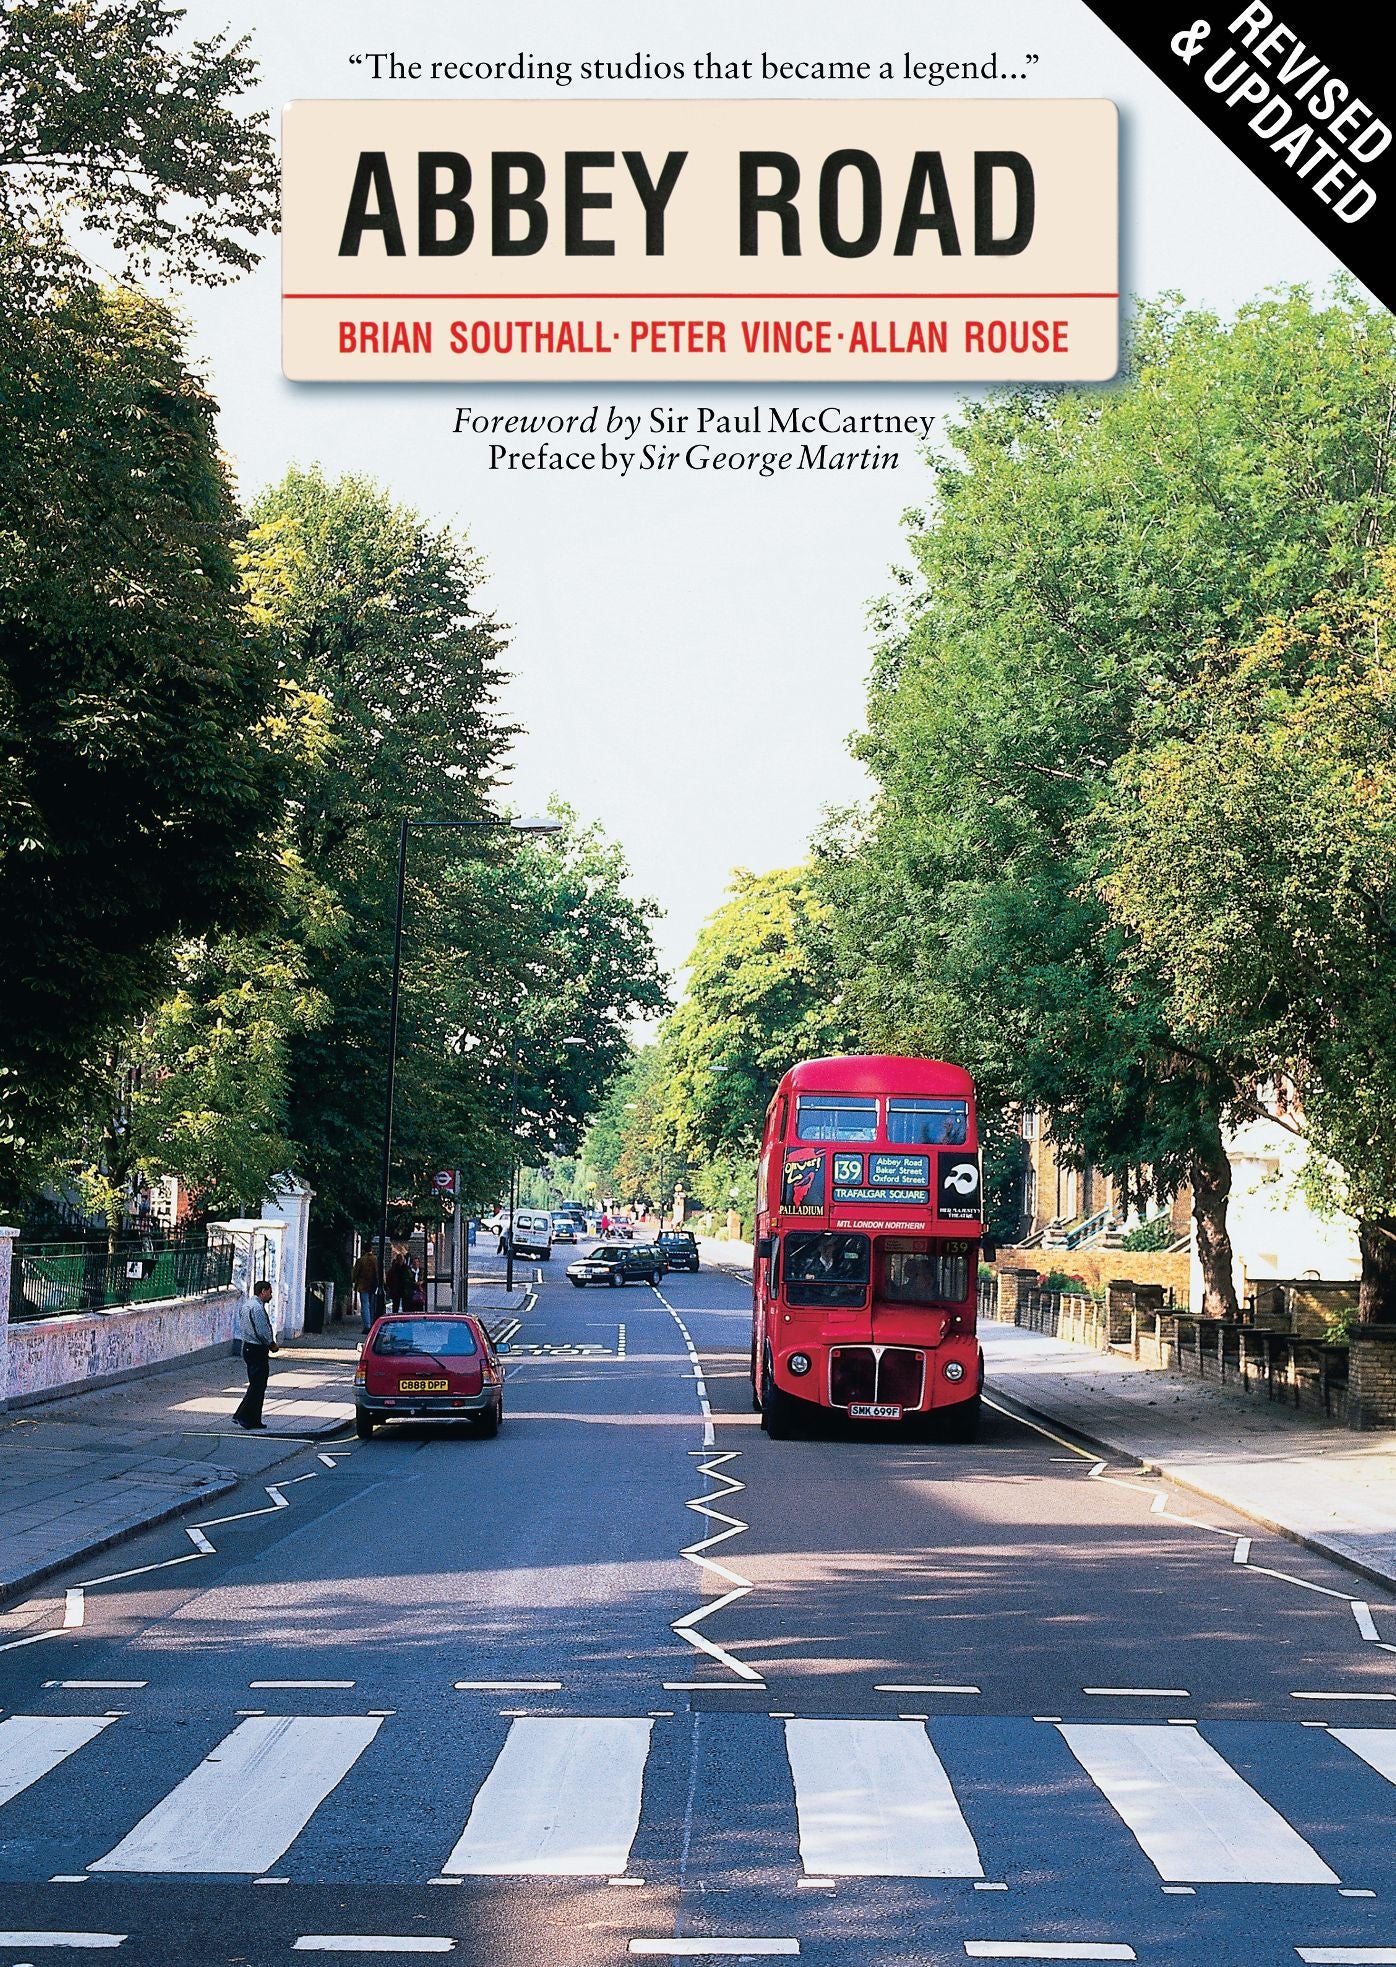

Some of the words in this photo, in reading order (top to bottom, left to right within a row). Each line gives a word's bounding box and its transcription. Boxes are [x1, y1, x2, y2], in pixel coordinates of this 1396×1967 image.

[876, 1157, 902, 1168] Abbey
[903, 1159, 923, 1167] Road
[834, 1160, 861, 1180] 139
[875, 1166, 897, 1174] Baker
[898, 1167, 923, 1176] Street
[872, 1174, 900, 1183] Oxford
[902, 1175, 926, 1184] Street
[835, 1189, 887, 1199] TRAFALGAR
[889, 1190, 926, 1200] SQUARE
[779, 1205, 824, 1216] PALLADIUM
[836, 1220, 852, 1228] MTL
[853, 1220, 885, 1229] LONDON
[885, 1221, 926, 1230] NORTHERN
[945, 1241, 968, 1253] 139
[401, 1381, 426, 1390] C888
[427, 1381, 447, 1390] DPP
[852, 1406, 871, 1415] SMK
[873, 1407, 898, 1416] 699F
